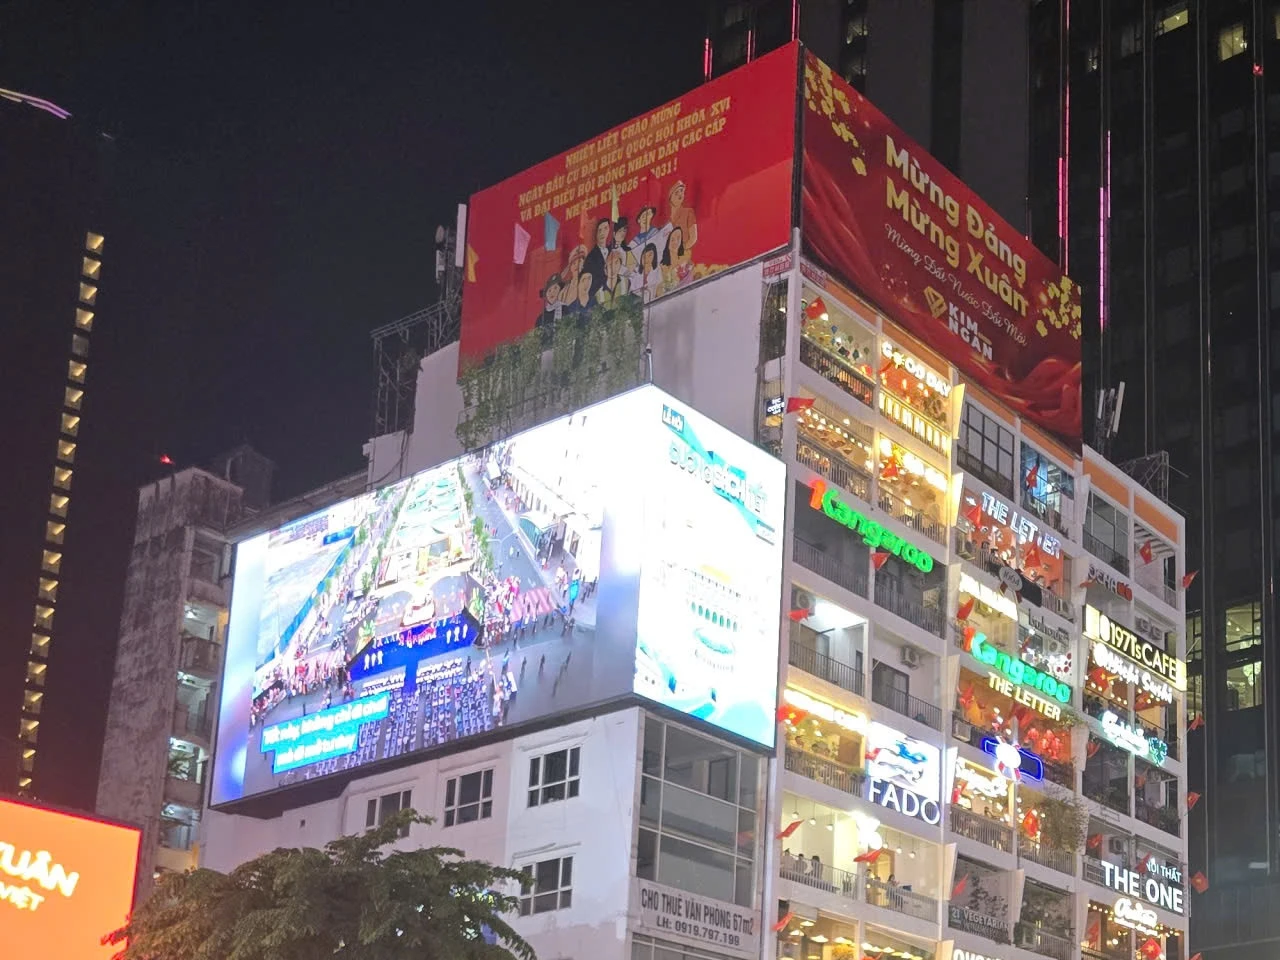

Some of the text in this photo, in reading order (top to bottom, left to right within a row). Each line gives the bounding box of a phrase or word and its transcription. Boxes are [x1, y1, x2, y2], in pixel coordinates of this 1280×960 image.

[886, 134, 1027, 284] Mừng Đảng
[886, 175, 1028, 318] Mừng Xuân
[949, 302, 979, 334] KIM
[982, 491, 1009, 526] THE
[1142, 643, 1178, 683] CAFE
[988, 671, 1062, 722] THE LETTER
[868, 778, 941, 826] FADO
[641, 887, 660, 911] CHO
[661, 892, 682, 918] THUÊ
[703, 903, 732, 930] PHÒNG
[1101, 860, 1184, 914] THE ONE
[656, 915, 673, 929] LH:
